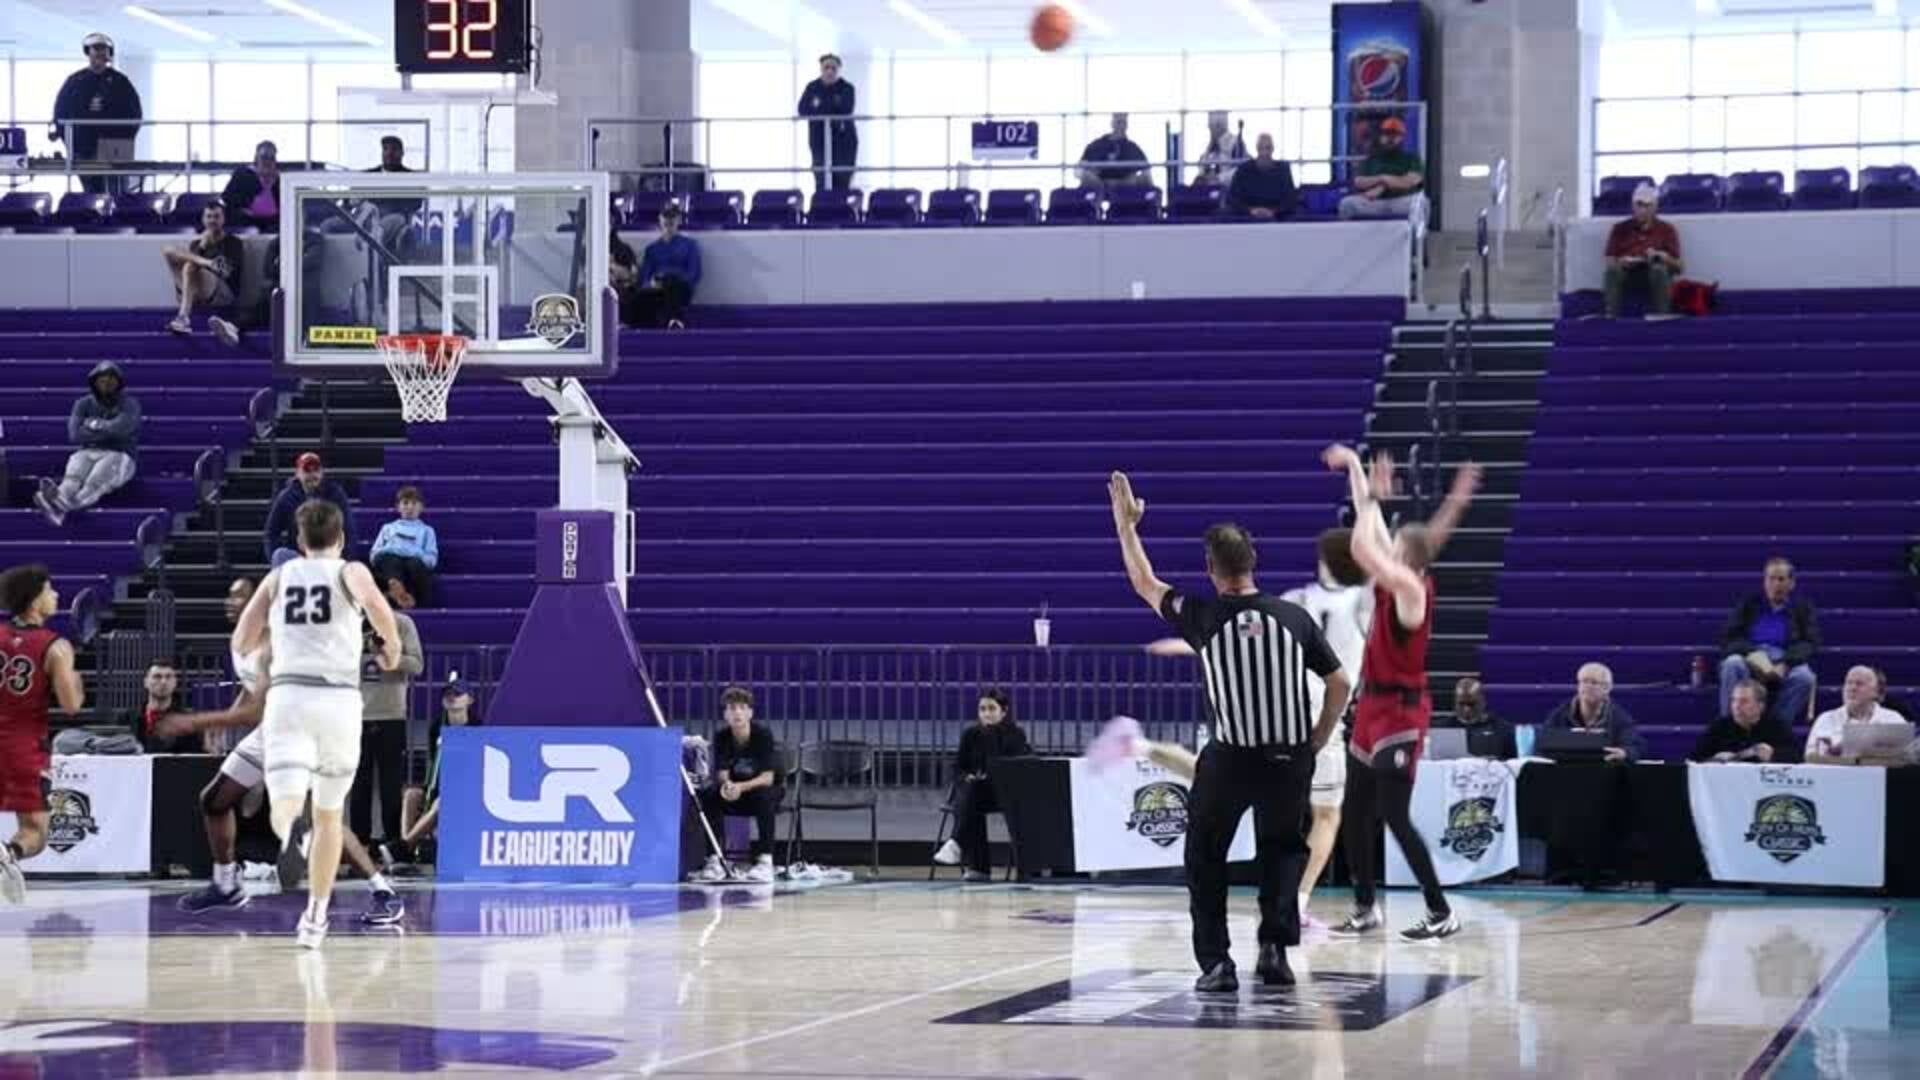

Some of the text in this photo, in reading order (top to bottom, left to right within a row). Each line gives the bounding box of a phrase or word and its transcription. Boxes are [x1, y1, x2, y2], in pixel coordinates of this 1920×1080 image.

[426, 0, 498, 59] 32
[996, 124, 1028, 143] 102
[313, 329, 373, 340] PANINI
[285, 584, 331, 625] 23
[480, 829, 635, 867] LEAGUEREADY
[1760, 836, 1809, 849] CLASSIC
